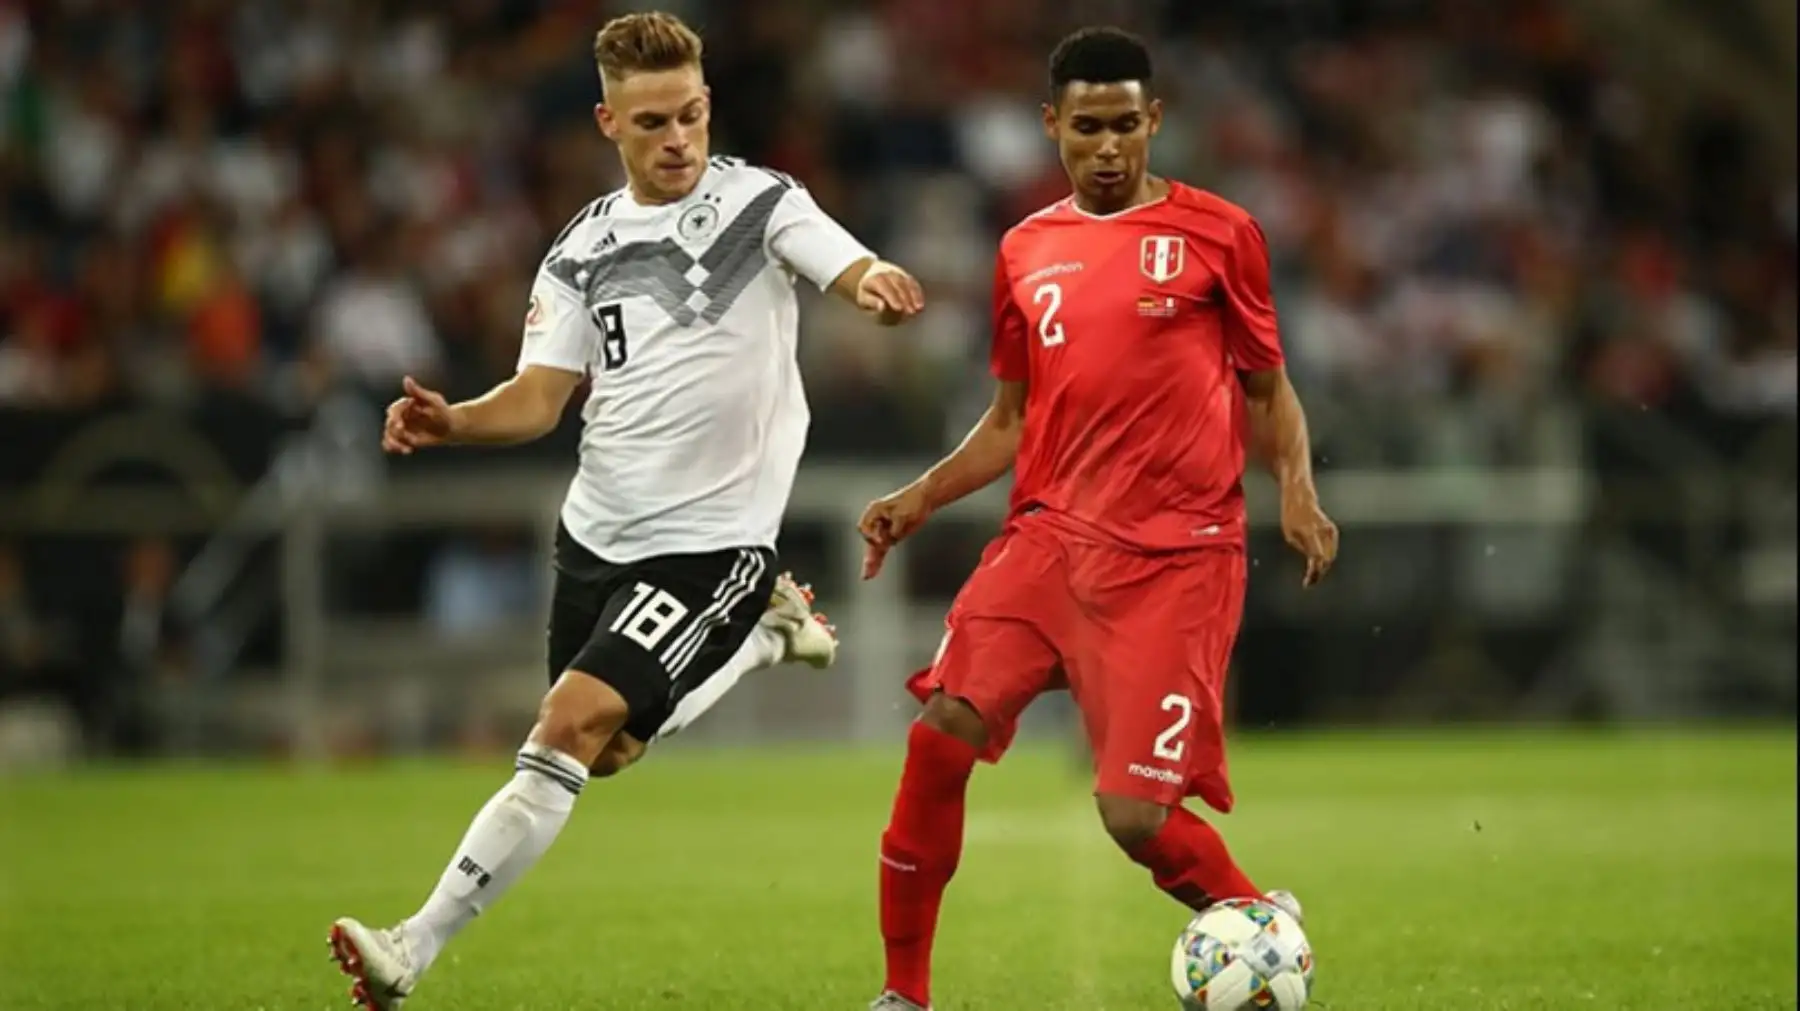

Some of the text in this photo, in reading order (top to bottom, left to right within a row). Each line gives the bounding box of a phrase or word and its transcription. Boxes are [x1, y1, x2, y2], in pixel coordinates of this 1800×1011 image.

[1033, 283, 1065, 347] 2
[609, 581, 689, 652] 18
[1153, 693, 1191, 761] 2
